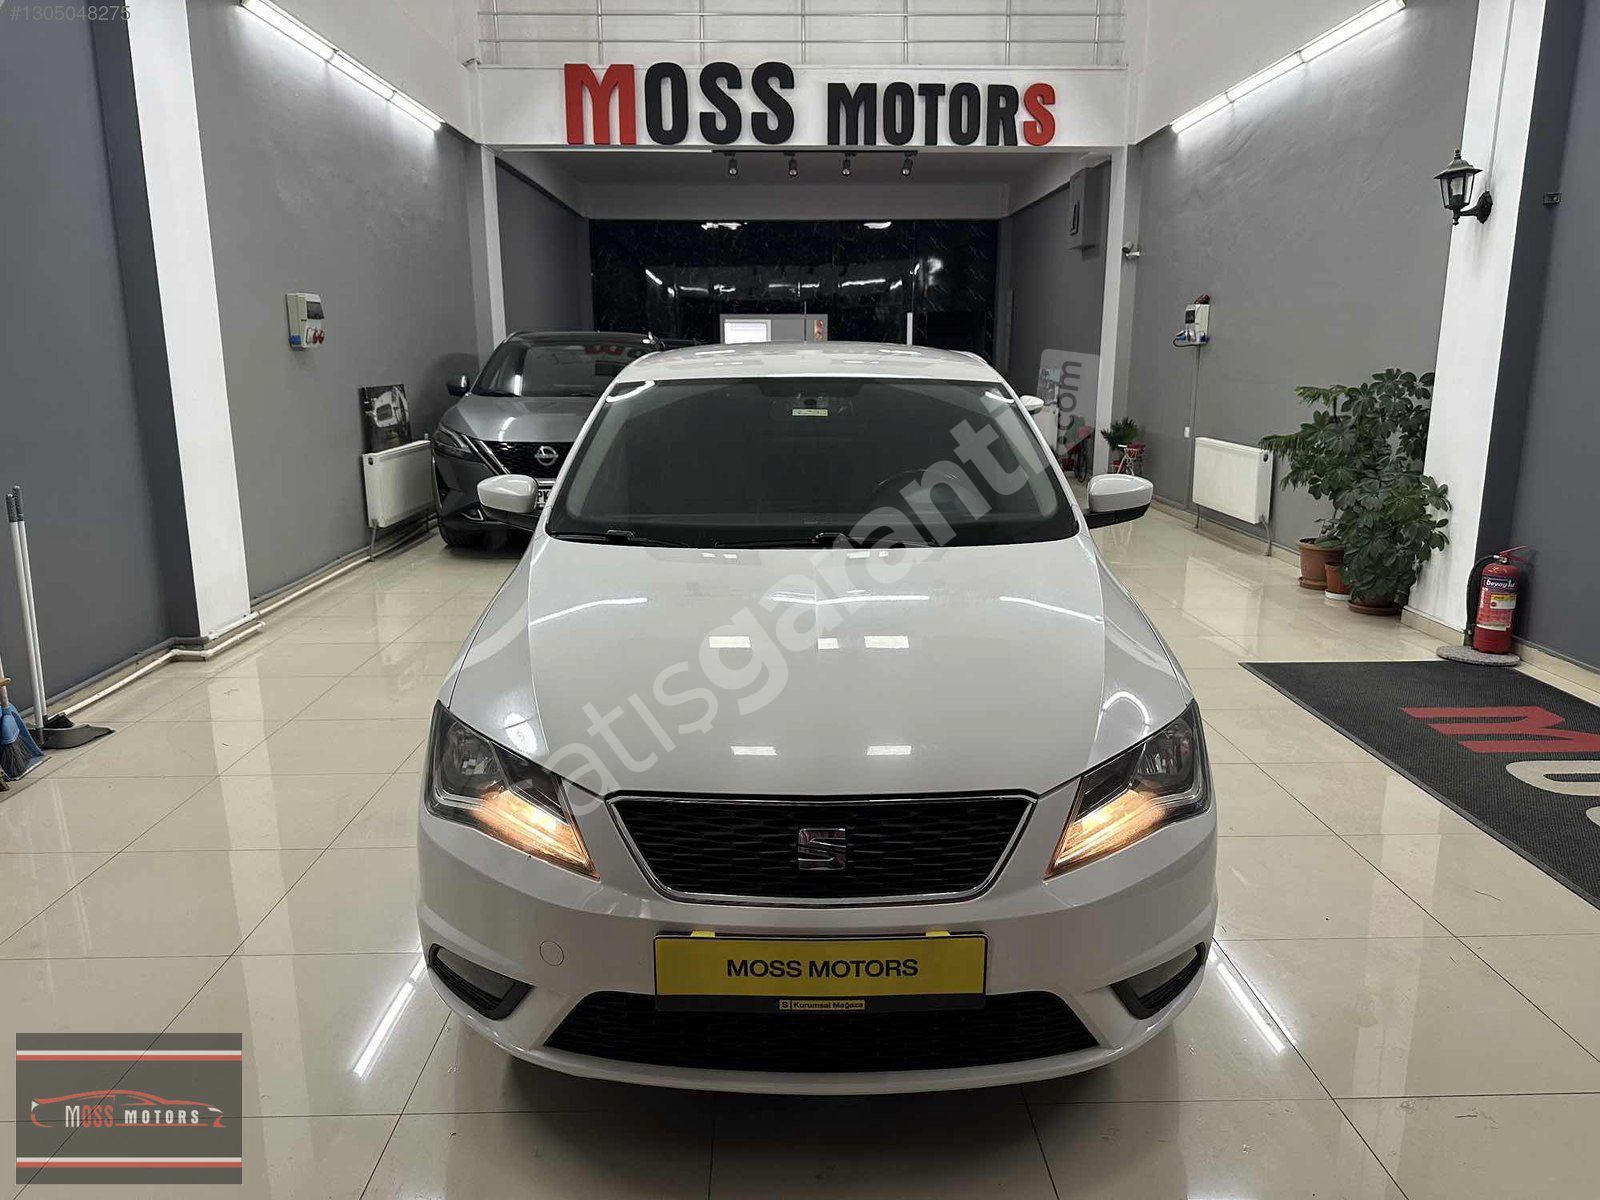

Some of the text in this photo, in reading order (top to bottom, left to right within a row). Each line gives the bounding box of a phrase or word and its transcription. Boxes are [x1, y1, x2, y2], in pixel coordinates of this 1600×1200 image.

[564, 61, 1056, 147] MOSS MOTORS
[727, 958, 919, 978] MOSS MOTORS
[793, 1001, 831, 1009] Kurumsal
[832, 1001, 864, 1010] Mağaza
